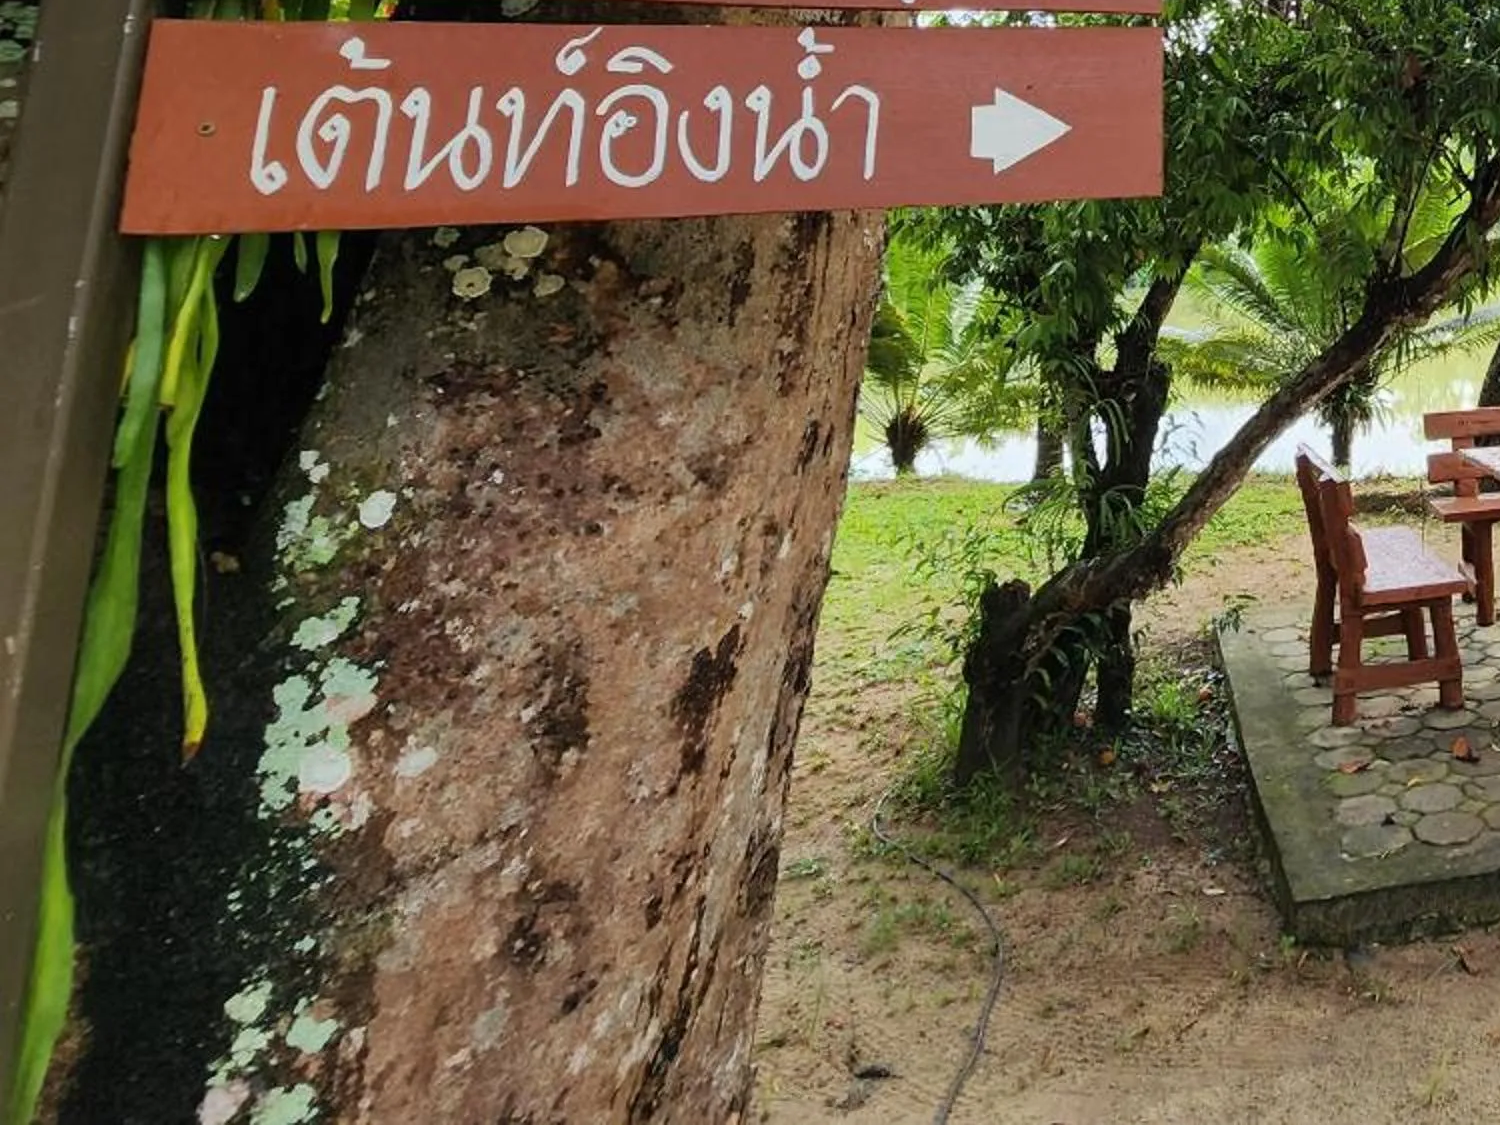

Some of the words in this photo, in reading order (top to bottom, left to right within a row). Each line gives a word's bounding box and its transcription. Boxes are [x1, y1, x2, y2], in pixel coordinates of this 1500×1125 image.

[249, 26, 881, 196] เต้นท์อิงน้ำ
